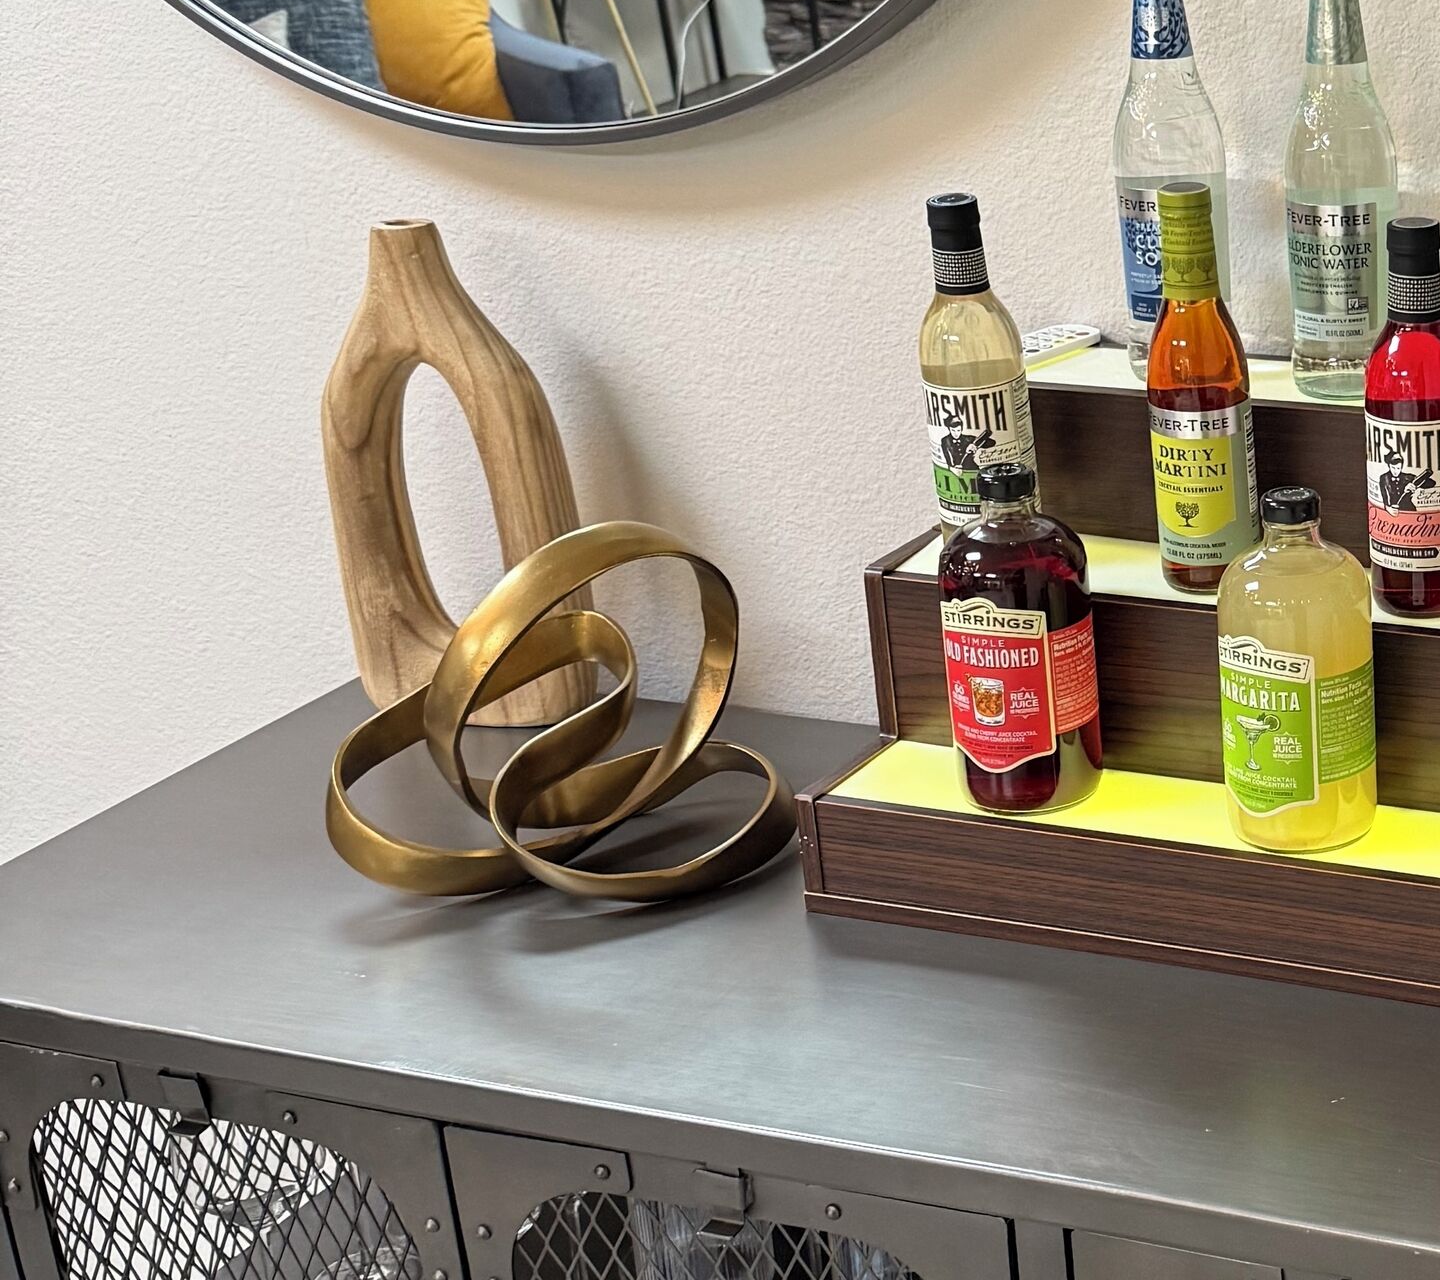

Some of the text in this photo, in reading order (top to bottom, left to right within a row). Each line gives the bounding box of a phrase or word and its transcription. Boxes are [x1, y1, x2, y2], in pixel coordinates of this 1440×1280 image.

[1119, 195, 1157, 212] FEVER
[1287, 207, 1371, 228] FEVER-TREE
[1136, 235, 1161, 250] CL
[1136, 251, 1159, 266] SO
[1323, 257, 1369, 270] WATER
[922, 389, 1008, 431] ARSMITH
[1159, 444, 1215, 462] DIRTY
[1154, 458, 1227, 478] MARTINI
[934, 468, 978, 495] LIM
[1183, 485, 1224, 494] ESSENTIALS
[944, 610, 1035, 630] STIRRINGS
[961, 635, 1005, 648] SIMPLE
[963, 647, 1039, 668] FASHIONED
[1219, 646, 1302, 673] STIRRINGS
[1230, 672, 1271, 689] SIMPLE
[1010, 692, 1038, 702] REAL
[1221, 679, 1301, 711] MARGARITA
[1009, 699, 1039, 709] JUICE
[1272, 744, 1303, 753] JUICE
[1274, 736, 1301, 745] REAL
[1251, 780, 1297, 789] CONCENTRATE
